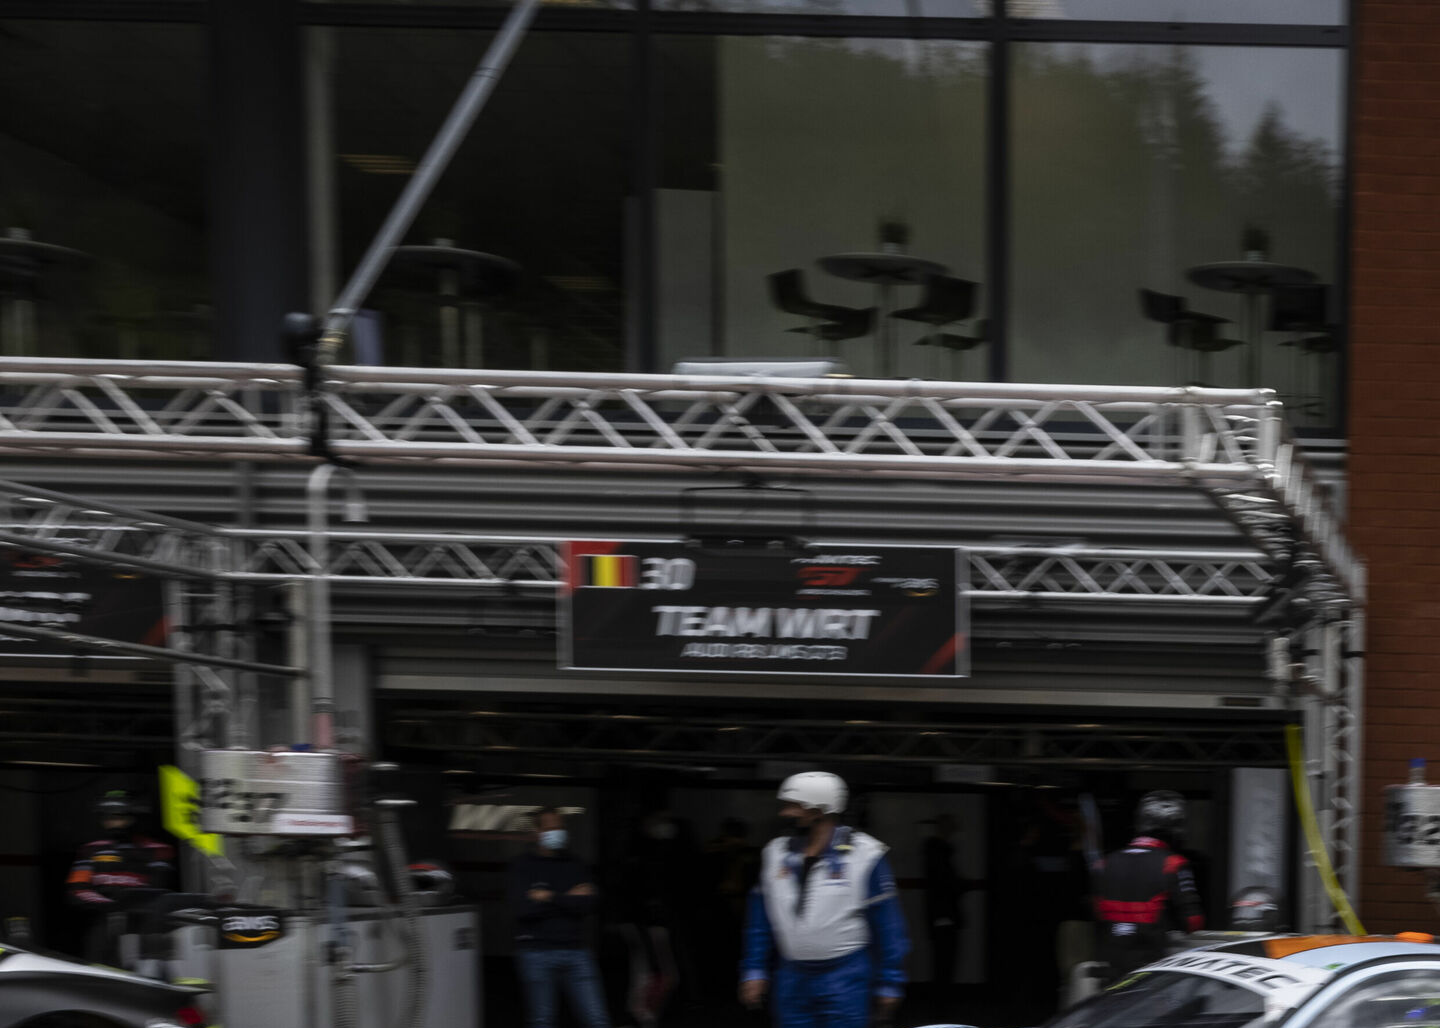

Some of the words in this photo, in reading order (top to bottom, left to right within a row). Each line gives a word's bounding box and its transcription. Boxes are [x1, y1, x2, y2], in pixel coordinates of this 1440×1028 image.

[642, 557, 696, 591] 30
[653, 605, 771, 638] TEAM
[775, 607, 881, 640] WRT
